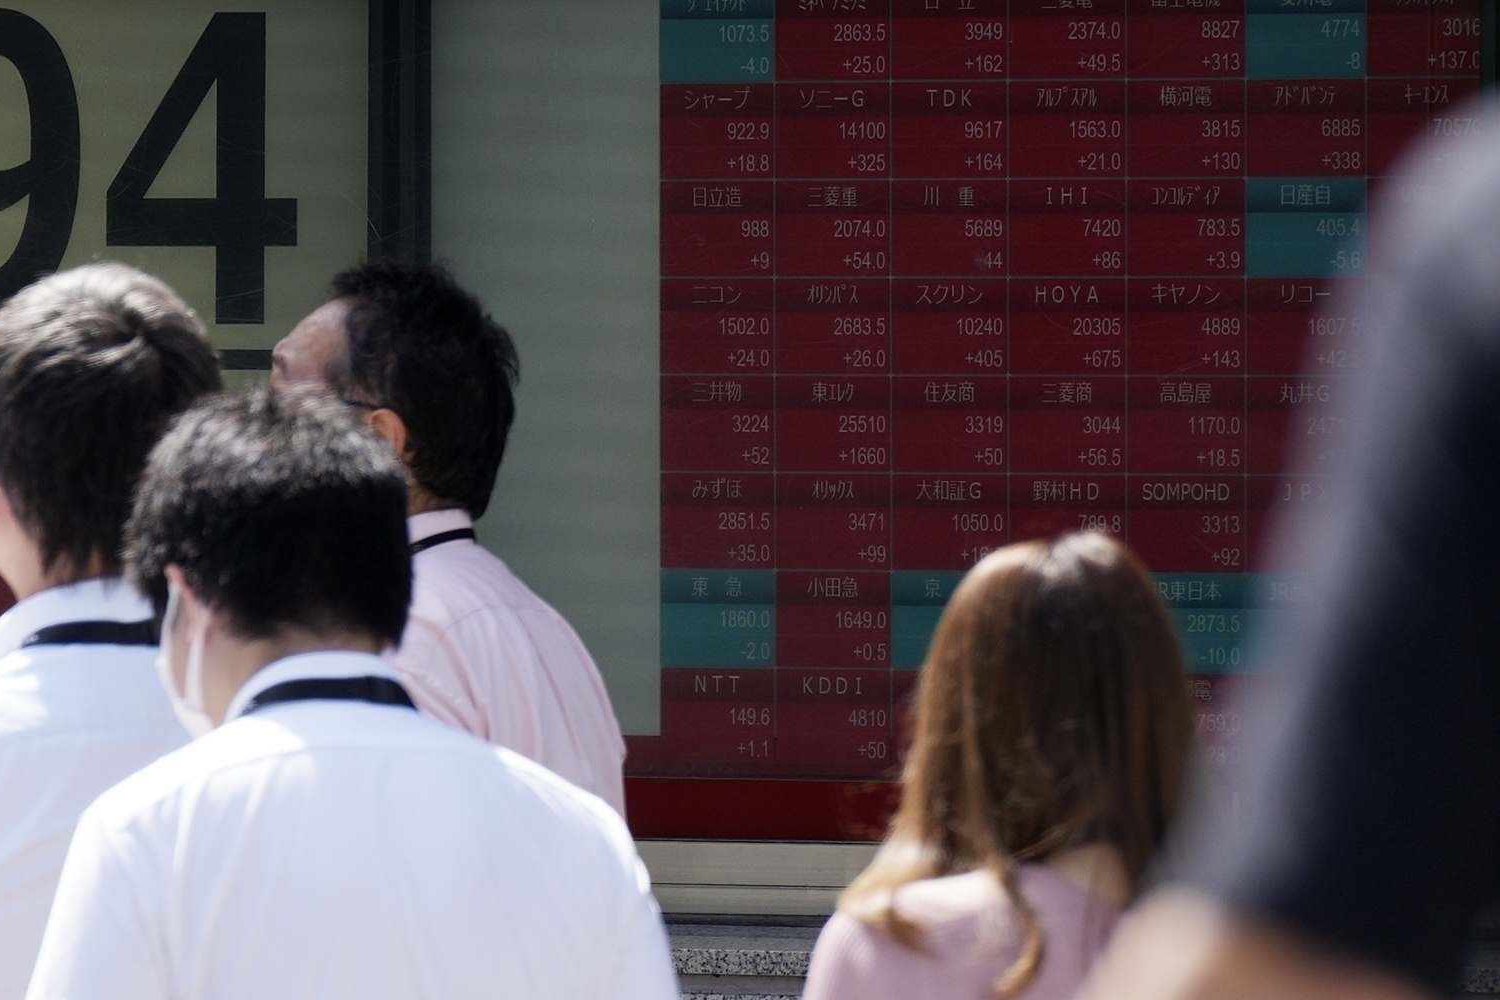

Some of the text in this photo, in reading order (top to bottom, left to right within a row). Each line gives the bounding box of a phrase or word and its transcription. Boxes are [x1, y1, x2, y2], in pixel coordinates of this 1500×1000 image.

[720, 24, 771, 42] 1073.5
[834, 23, 886, 42] 2863.5
[965, 22, 1003, 40] 3949
[1068, 21, 1121, 40] 2374.0
[1202, 20, 1240, 38] 8827
[1321, 19, 1359, 37] 4774
[740, 57, 769, 74] -4.0
[843, 55, 885, 73] +25.0
[965, 54, 1002, 72] +162
[1077, 53, 1120, 72] +49.5
[1202, 53, 1240, 70] +313
[1345, 52, 1360, 69] -8
[1159, 86, 1212, 106] 横河電
[1404, 84, 1448, 104] キーエンス
[727, 122, 769, 140] 922.9
[840, 121, 885, 139] 14100
[965, 120, 1003, 139] 9617
[1069, 120, 1121, 138] 1563.0
[1202, 119, 1240, 137] 3815
[1322, 118, 1360, 137] 6885
[727, 154, 769, 172] +18.8
[848, 154, 885, 171] +325
[965, 153, 1002, 171] +164
[1078, 152, 1121, 171] +21.0
[1202, 152, 1240, 170] +130
[1322, 151, 1360, 169] +338
[693, 186, 741, 207] 日立造
[808, 186, 857, 207] 三菱重
[1281, 184, 1330, 204] 日産自
[741, 220, 769, 237] 988
[834, 219, 885, 237] 2074.0
[965, 219, 1003, 237] 5689
[1083, 219, 1121, 237] 7420
[1197, 218, 1240, 236] 783.5
[1317, 219, 1359, 236] 405.4
[751, 252, 769, 269] +9
[843, 252, 885, 269] +54.0
[974, 251, 1003, 269] 44
[1092, 251, 1121, 269] +86
[1206, 251, 1240, 268] +3.9
[1330, 251, 1360, 268] -5.6
[719, 317, 769, 335] 1502.0
[834, 317, 885, 335] 2683.5
[957, 317, 1003, 335] 10240
[1073, 317, 1121, 335] 20305
[1201, 317, 1240, 335] 4889
[727, 349, 769, 367] +24.0
[843, 349, 885, 367] +26.0
[965, 349, 1003, 367] +405
[1083, 350, 1121, 367] +675
[1202, 350, 1240, 368] +143
[693, 381, 742, 401] 三井物
[924, 381, 974, 402] 住友商
[1042, 381, 1092, 403] 三菱商
[1160, 382, 1211, 403] 高島屋
[1279, 383, 1330, 403] 丸井G
[733, 415, 769, 432] 3224
[839, 415, 886, 433] 25510
[965, 415, 1003, 433] 3319
[1083, 416, 1121, 434] 3044
[1188, 416, 1240, 434] 1170.0
[742, 447, 769, 464] +52
[839, 447, 886, 465] +1660
[975, 448, 1003, 465] +50
[1078, 448, 1121, 466] +56.5
[1197, 449, 1240, 466] +18.5
[692, 478, 742, 498] みずほ
[916, 480, 981, 501] 大和証G
[1033, 481, 1099, 501] 野村HD
[1142, 483, 1230, 501] SOMPOHD
[719, 512, 770, 530] 2851.5
[849, 513, 884, 531] 3471
[952, 514, 1003, 531] 1050.0
[1202, 515, 1240, 533] 3313
[728, 544, 770, 561] +35.0
[858, 545, 886, 563] +99
[1211, 548, 1240, 565] +92
[808, 576, 858, 598] 小田急
[1153, 580, 1222, 601] R東日本
[721, 610, 770, 627] 1860.0
[836, 611, 886, 629] 1649.0
[1187, 615, 1240, 633] 2873.5
[741, 642, 769, 660] -2.0
[853, 643, 886, 660] +0.5
[1200, 648, 1240, 665] -10.0
[730, 708, 770, 725] 149.6
[848, 709, 886, 727] 4810
[737, 740, 768, 757] +1.1
[858, 741, 886, 759] +50
